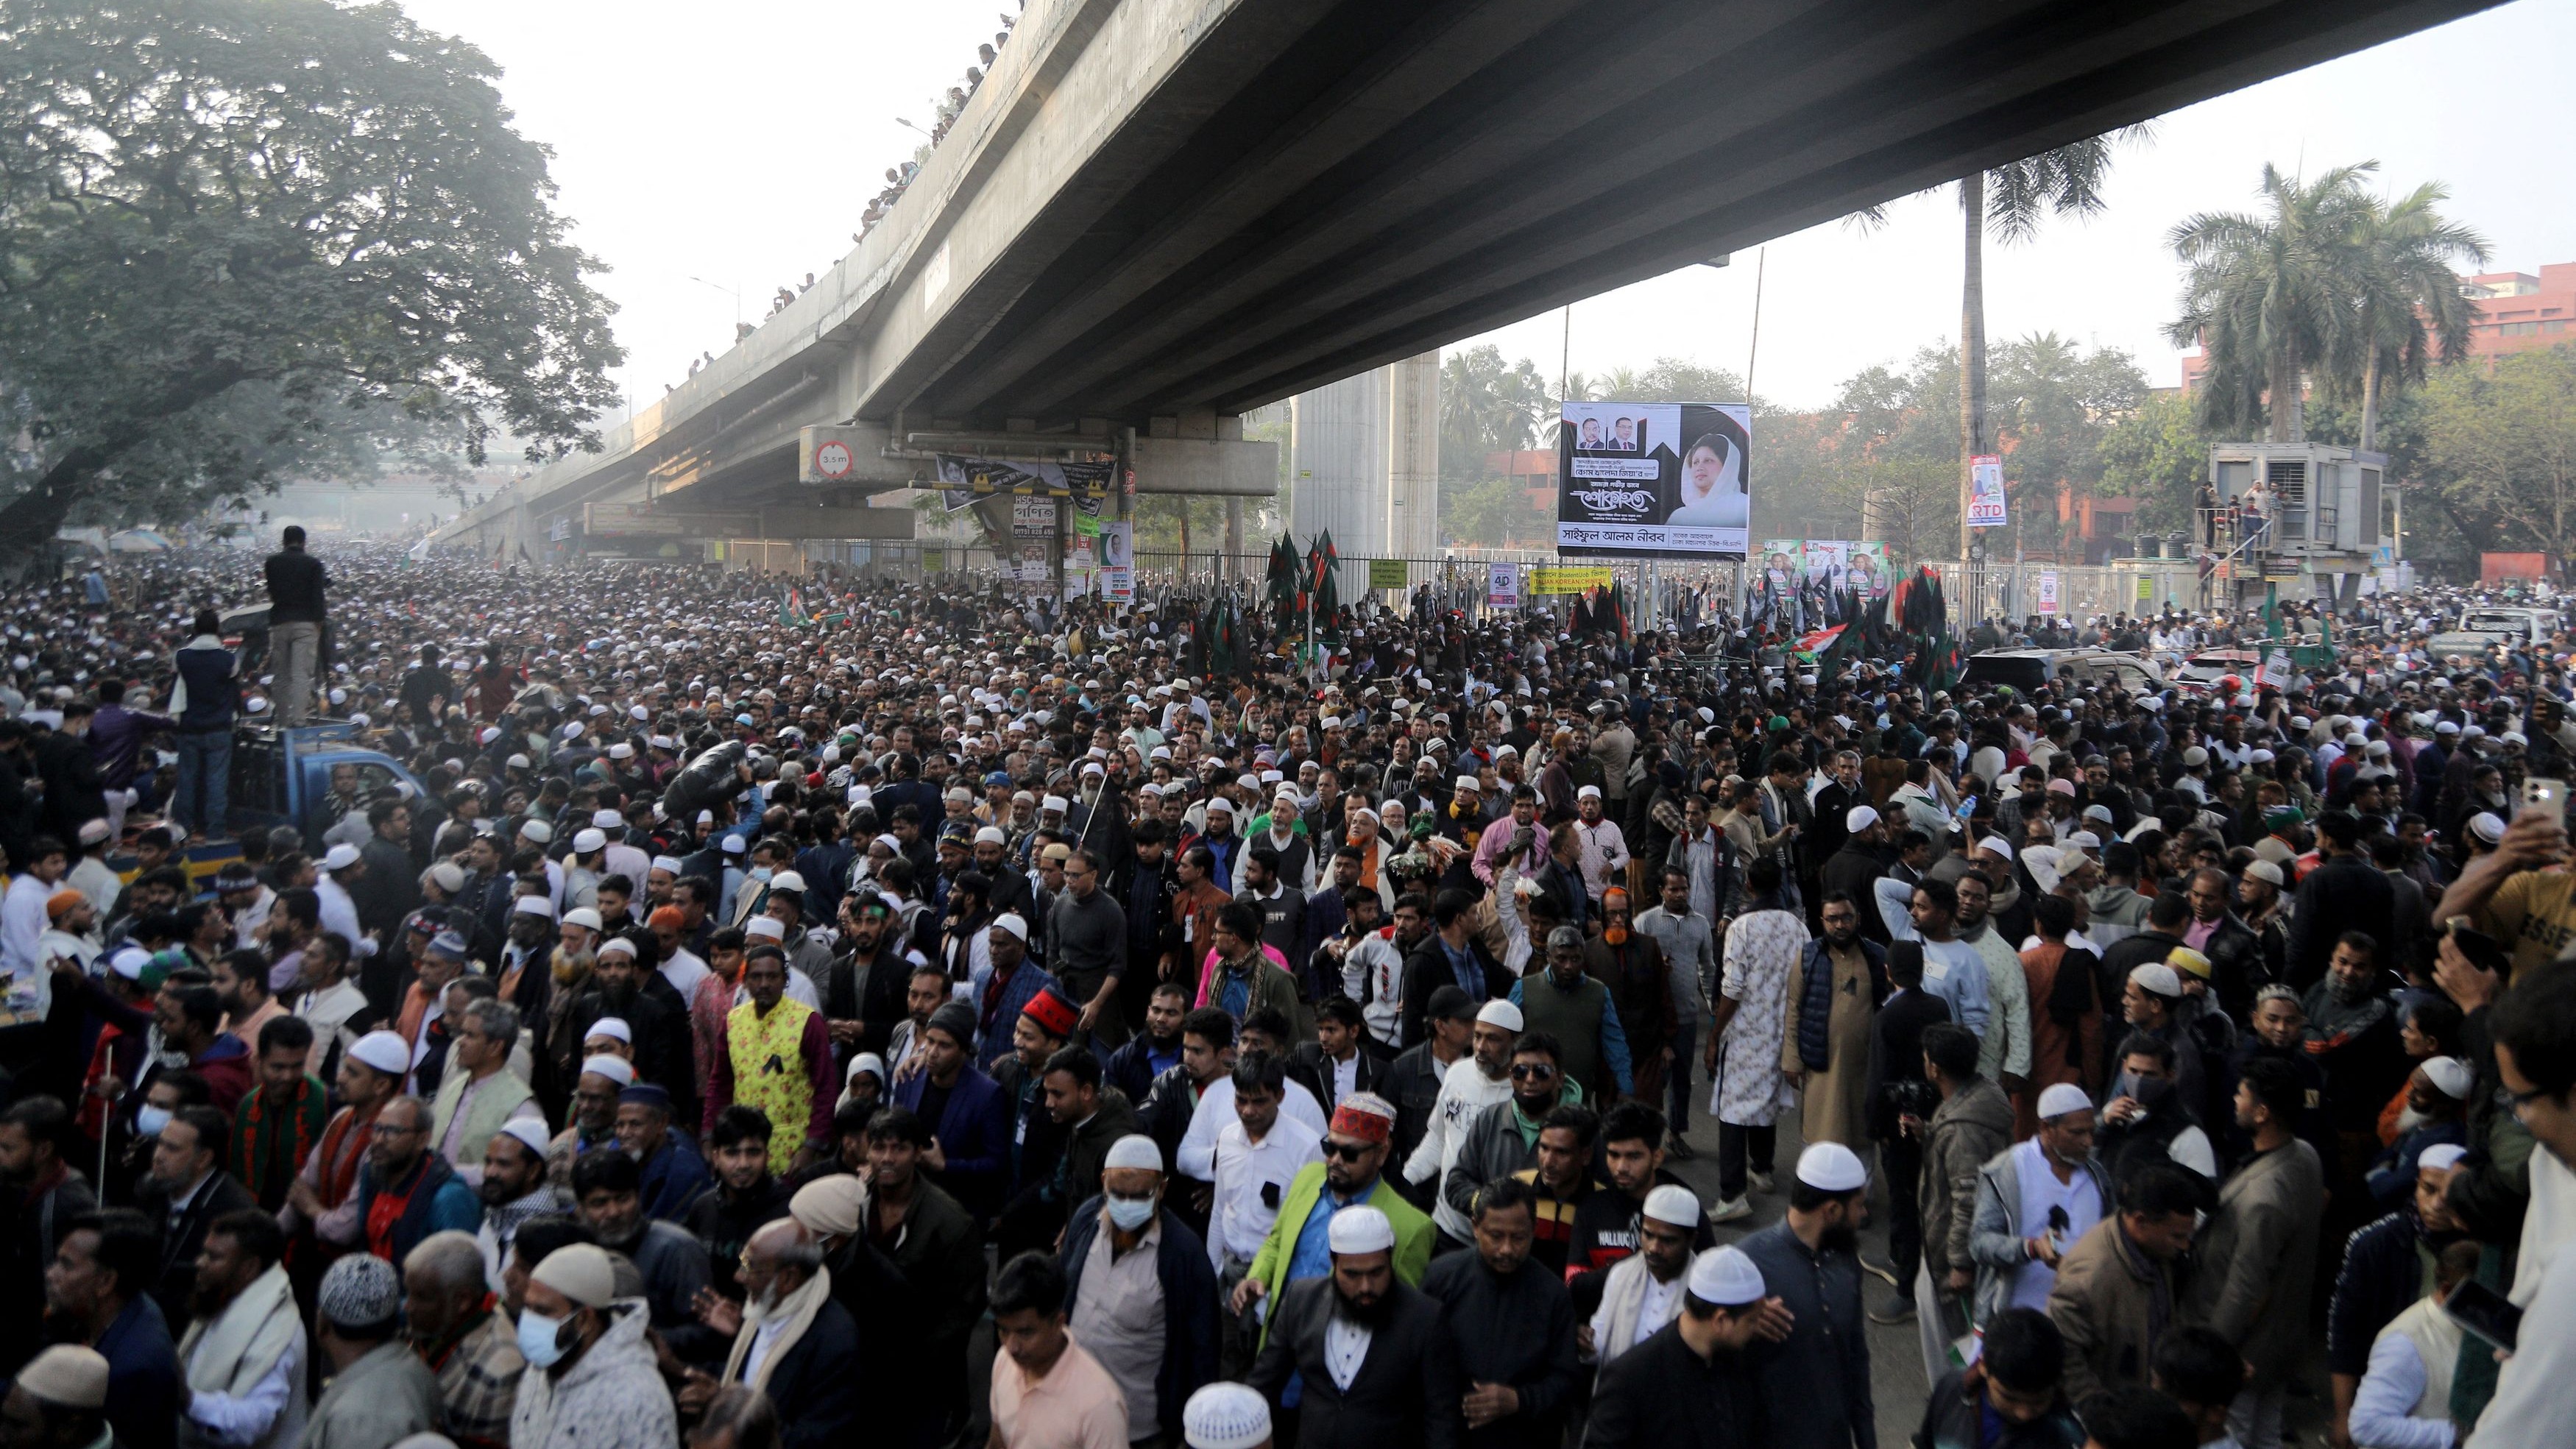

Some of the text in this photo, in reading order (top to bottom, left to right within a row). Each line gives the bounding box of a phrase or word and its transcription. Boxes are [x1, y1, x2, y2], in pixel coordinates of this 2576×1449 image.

[1016, 495, 1033, 504] HSC
[1015, 504, 1055, 517] গণিত
[1972, 505, 2003, 517] RTD
[1562, 528, 1665, 543] সাইফুল আলম নীরব
